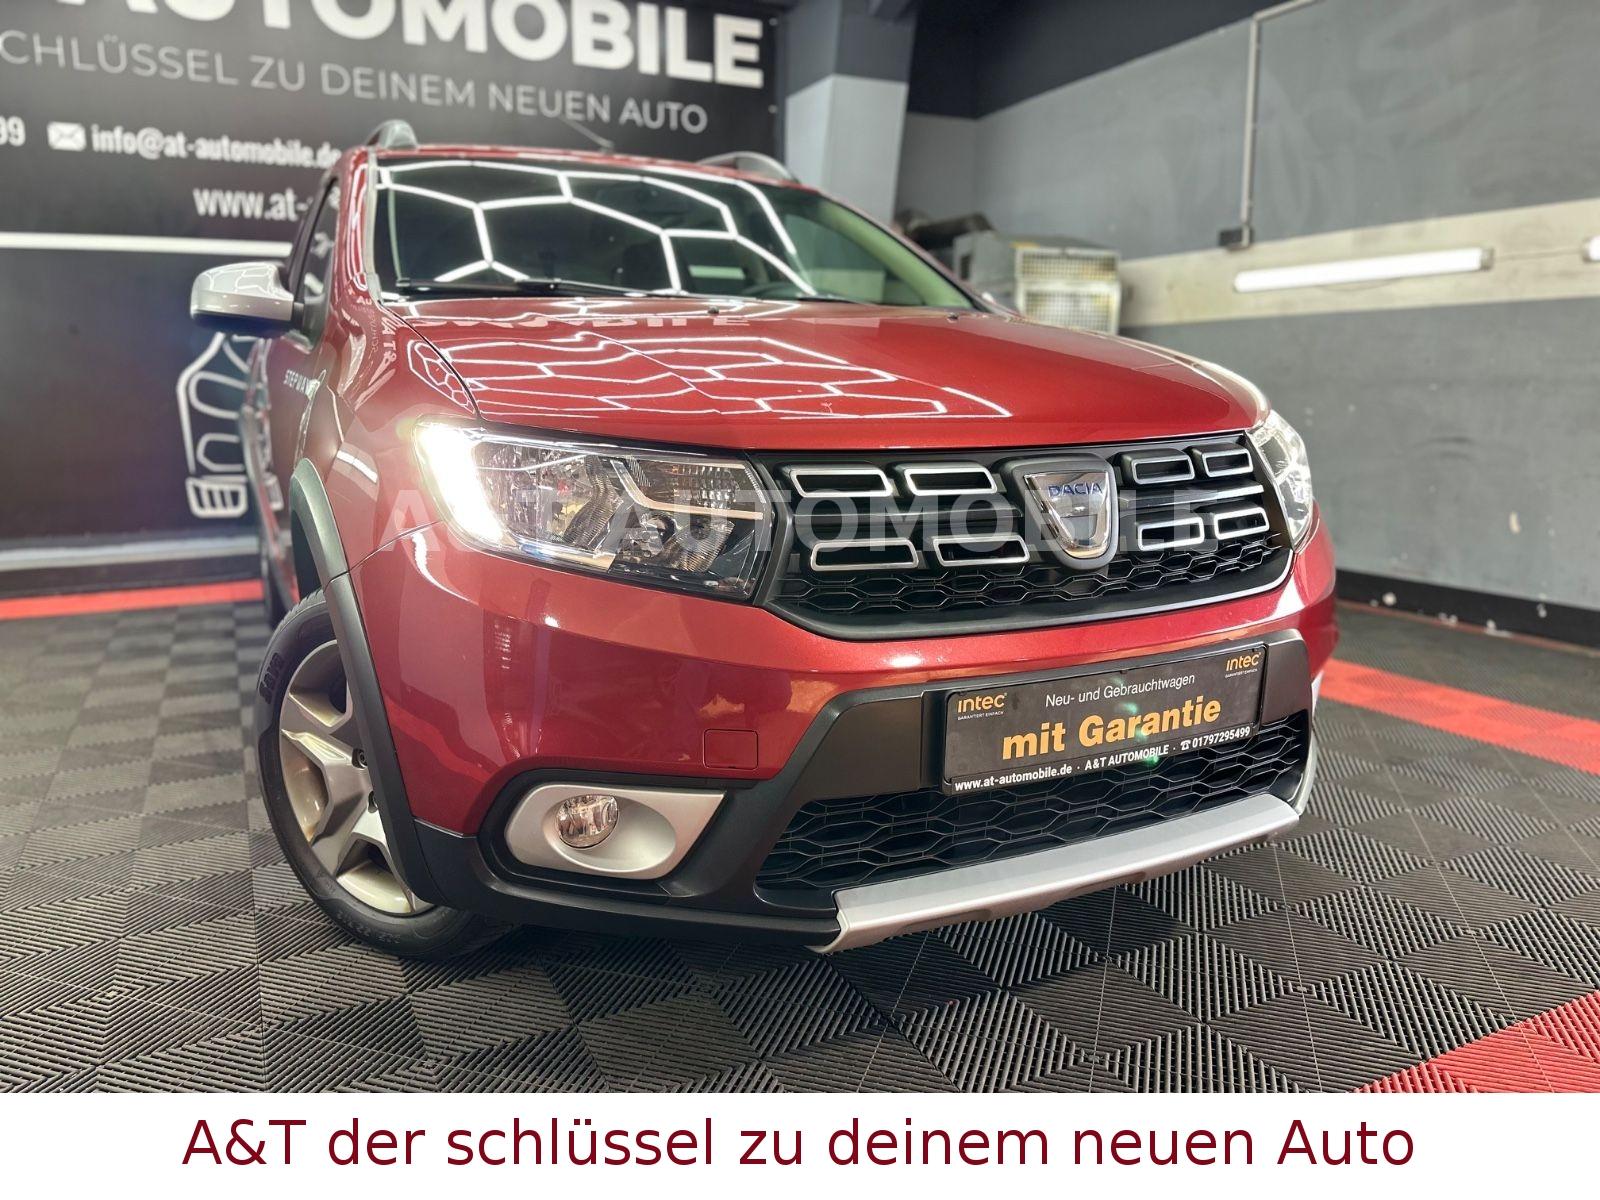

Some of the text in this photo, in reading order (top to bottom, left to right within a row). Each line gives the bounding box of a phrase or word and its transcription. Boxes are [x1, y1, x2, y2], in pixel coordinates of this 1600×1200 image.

[250, 55, 306, 91] ZU
[320, 62, 475, 109] DEINEM
[488, 82, 610, 124] NEUEN
[619, 97, 708, 134] AUTO
[1047, 483, 1103, 498] DACIA
[1225, 654, 1260, 672] intec
[957, 693, 1006, 713] intec
[1045, 673, 1196, 708] Neu- und Gebrauchtwagen
[1002, 695, 1222, 760] mit Garantie
[954, 726, 1251, 791] www.at-automobile.de A&T AUTOMOBILE 01797295499
